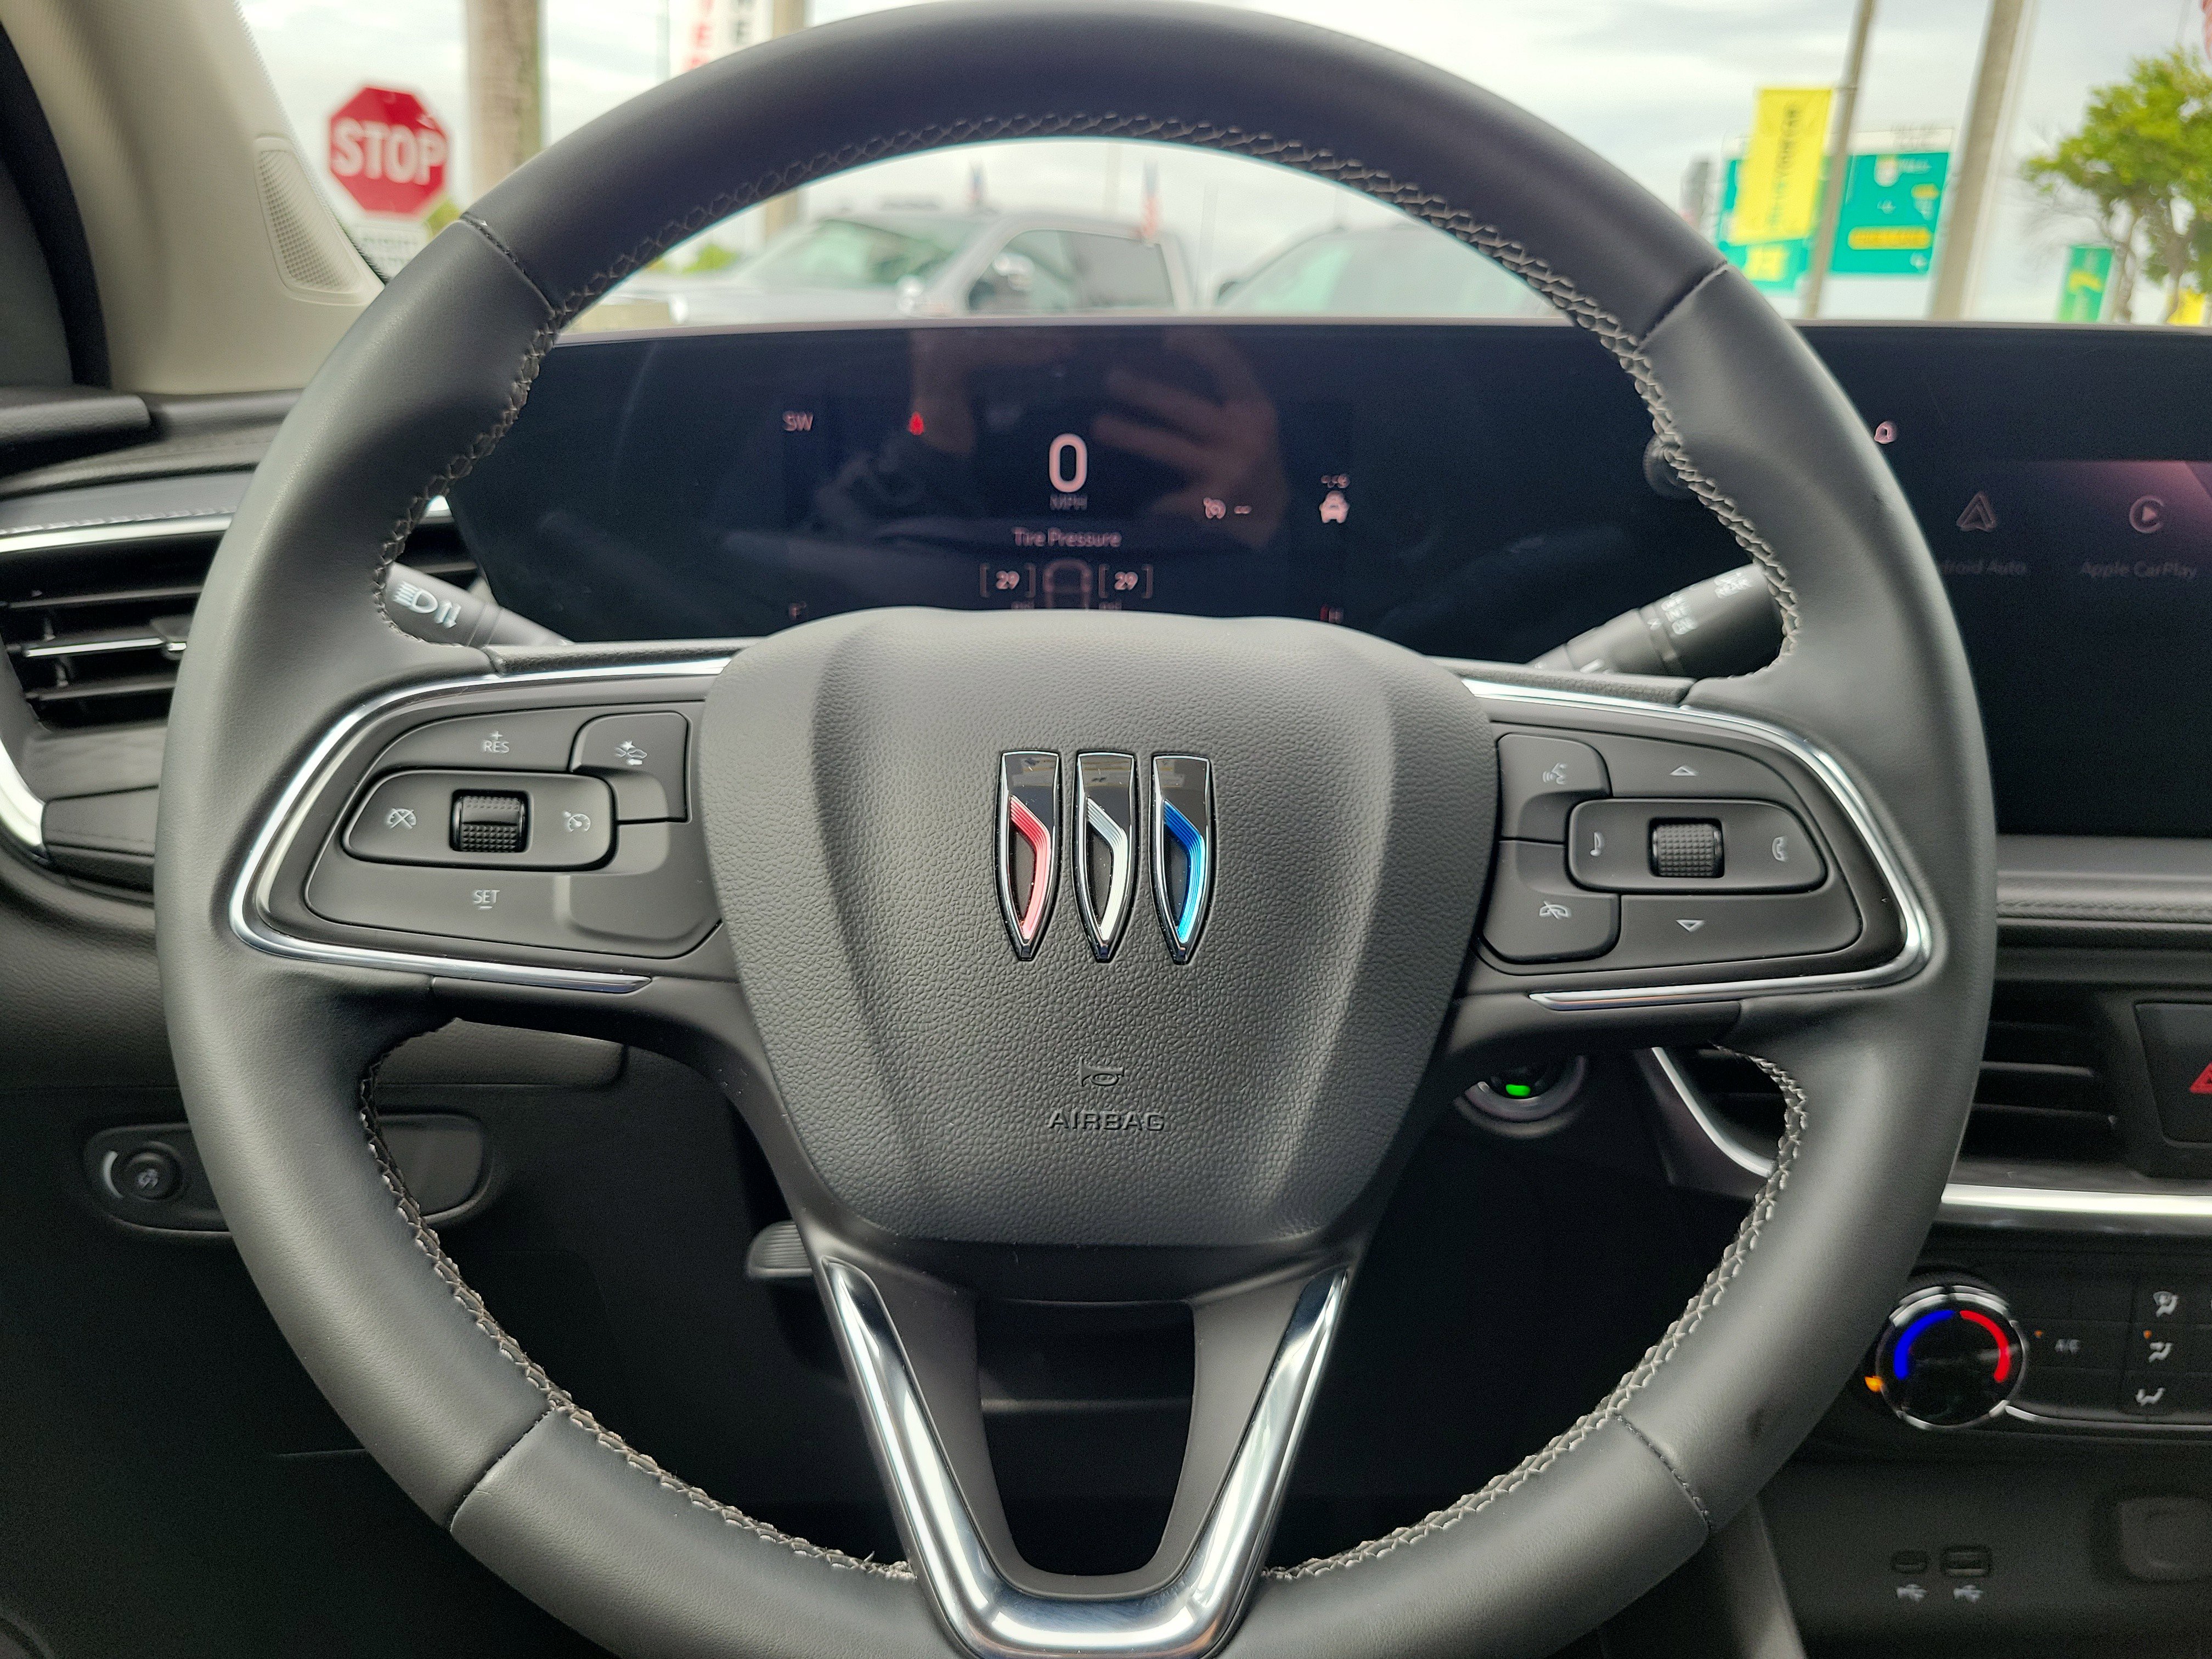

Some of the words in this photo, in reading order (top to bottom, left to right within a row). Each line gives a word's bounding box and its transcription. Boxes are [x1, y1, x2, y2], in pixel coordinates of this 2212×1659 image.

[332, 116, 448, 185] STOP
[782, 411, 814, 431] SW
[1049, 433, 1087, 493] 0
[1012, 527, 1046, 547] Tire
[1047, 527, 1122, 548] Pressure
[996, 571, 1020, 590] 29
[2134, 561, 2196, 580] CarPlay
[1114, 571, 1138, 591] 29
[484, 740, 510, 753] RES
[473, 889, 500, 903] SET
[1048, 1109, 1165, 1131] AIRBAG
